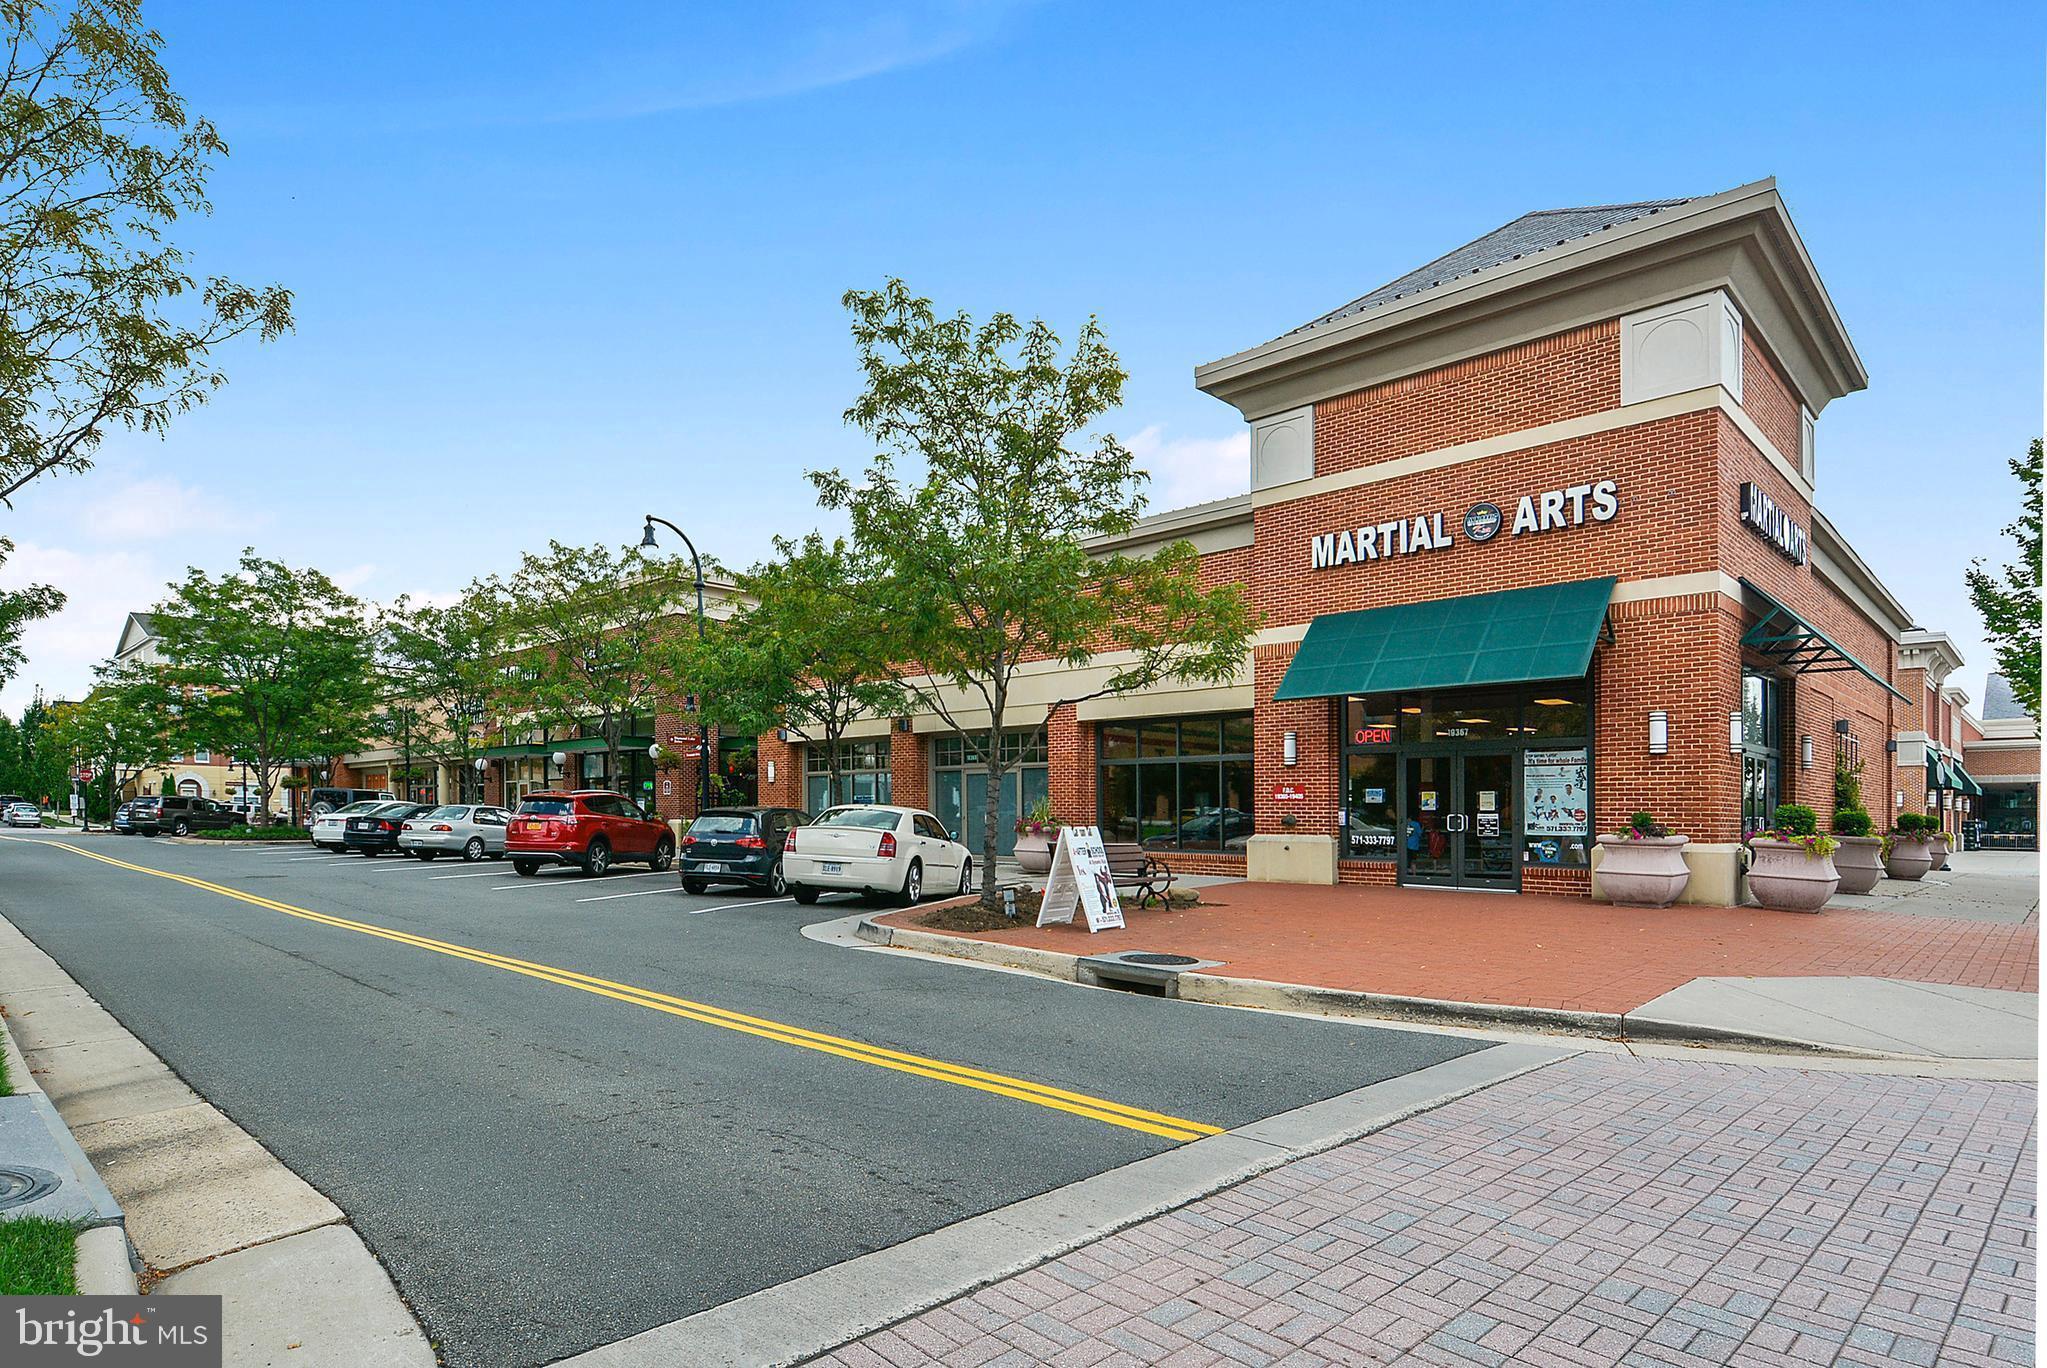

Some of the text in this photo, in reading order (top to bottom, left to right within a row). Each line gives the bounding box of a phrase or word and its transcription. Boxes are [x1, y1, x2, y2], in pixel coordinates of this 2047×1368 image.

[1311, 513, 1453, 569] MARTIAL
[1511, 480, 1618, 535] ARTS
[1749, 482, 1807, 567] MARTIAL ARTS
[1355, 729, 1391, 744] OPEN
[1351, 835, 1395, 846] 571-333-7797
